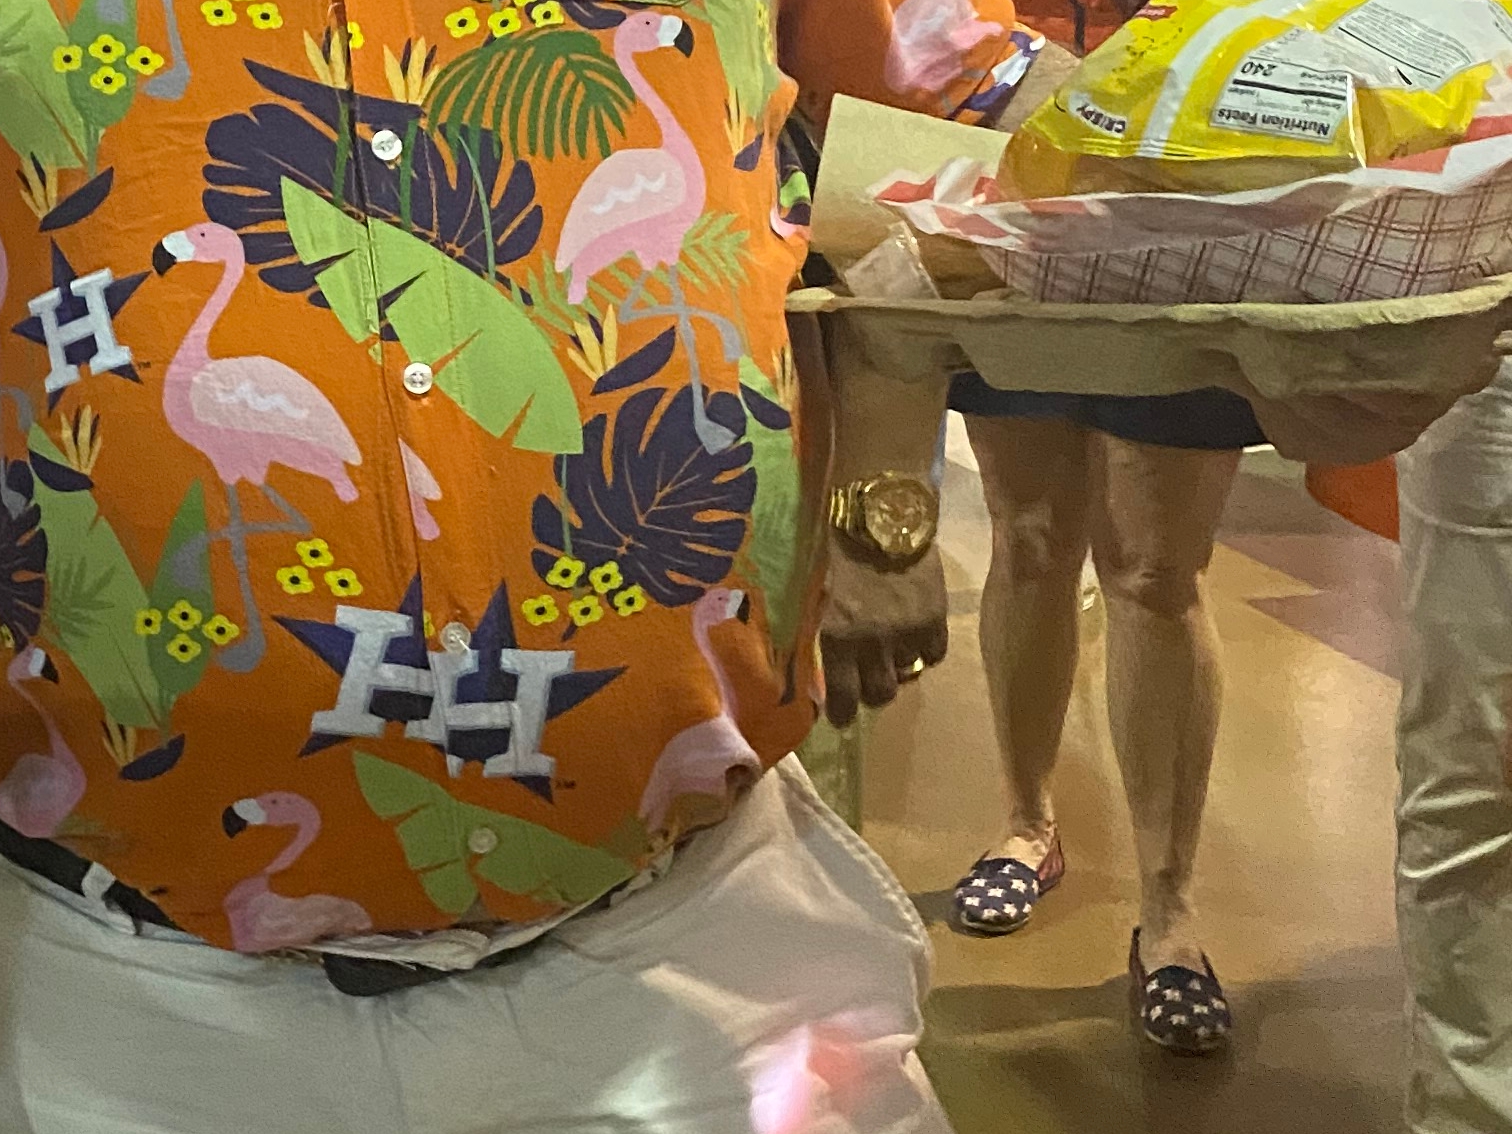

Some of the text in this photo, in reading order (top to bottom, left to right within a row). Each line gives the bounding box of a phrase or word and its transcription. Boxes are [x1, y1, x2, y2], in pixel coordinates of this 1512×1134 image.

[1240, 61, 1278, 77] 240
[1076, 103, 1126, 134] CRISPY
[1217, 107, 1258, 126] Facts
[1261, 113, 1331, 136] Nutrition
